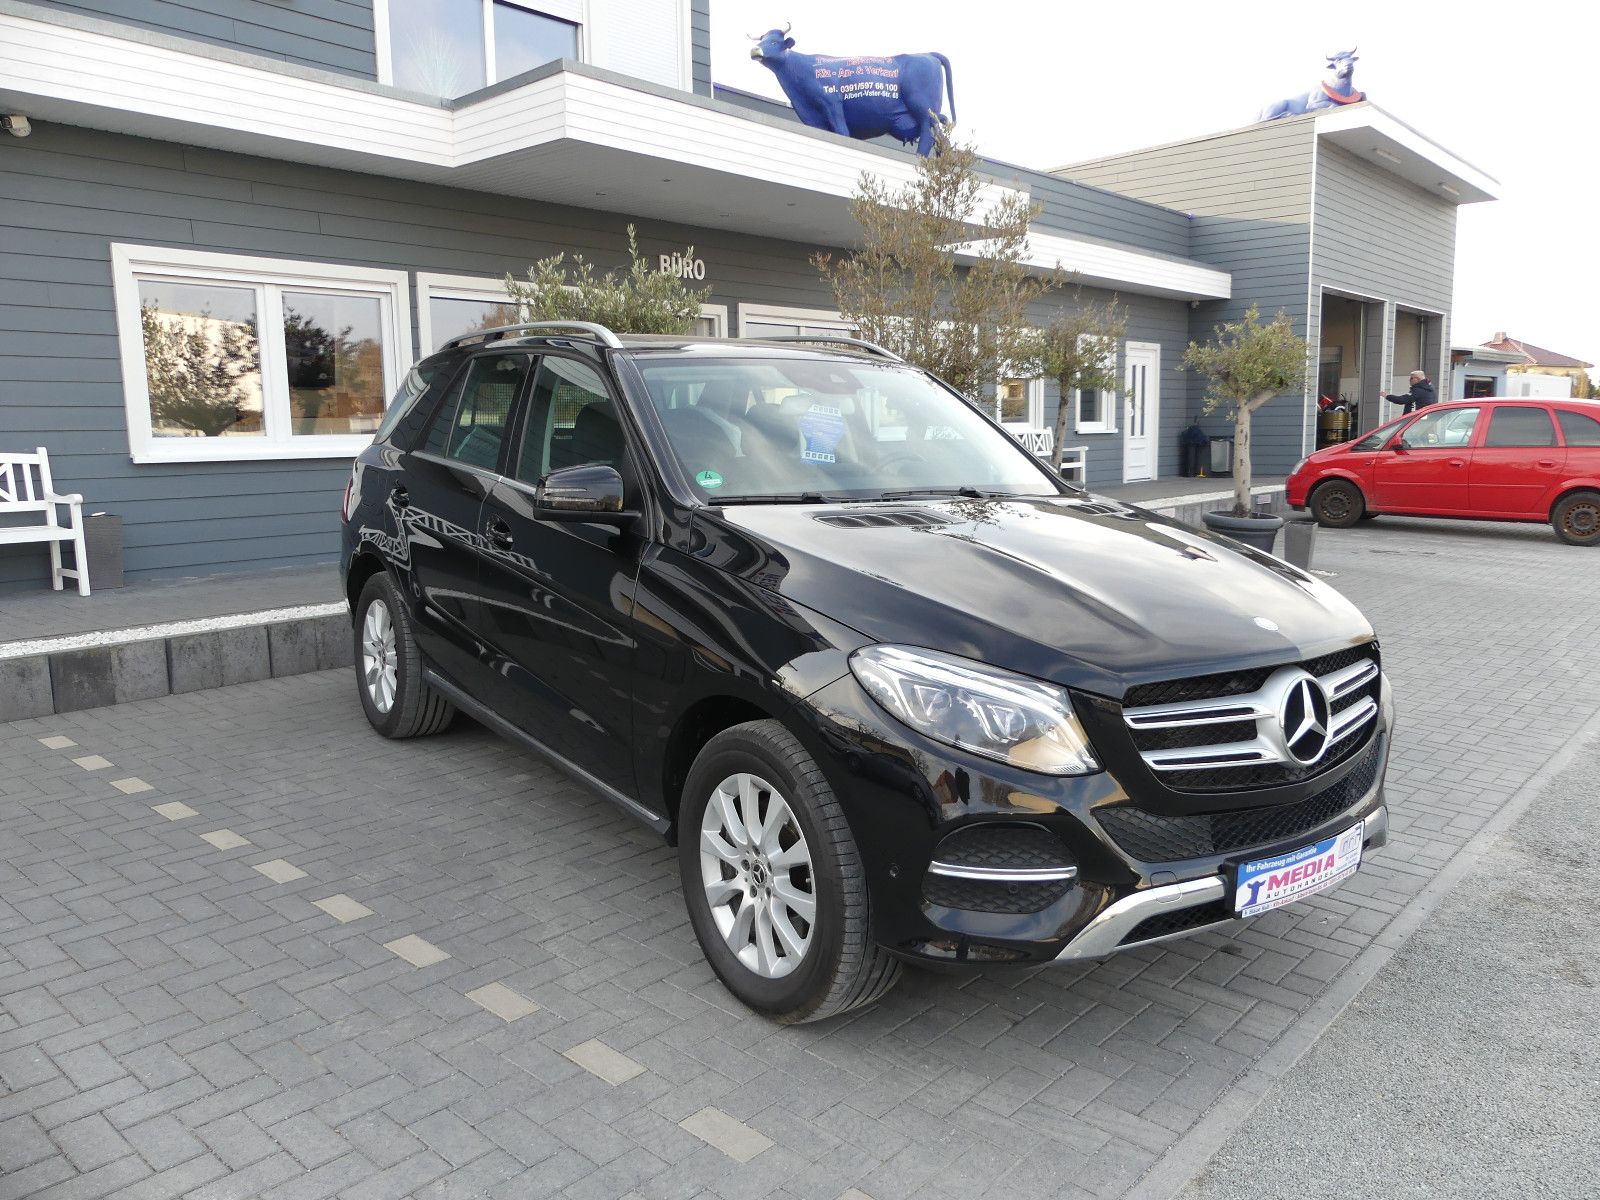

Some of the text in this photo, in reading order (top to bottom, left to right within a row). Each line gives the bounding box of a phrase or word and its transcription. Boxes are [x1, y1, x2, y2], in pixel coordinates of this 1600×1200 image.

[823, 85, 838, 93] Tel.
[840, 82, 873, 93] 0391/597
[886, 83, 898, 92] 100
[660, 252, 706, 280] BÜRO
[1246, 863, 1256, 873] Ihr
[1257, 858, 1286, 871] Fahrzeug
[1286, 855, 1296, 864] mit
[1267, 854, 1335, 891] MEDIA
